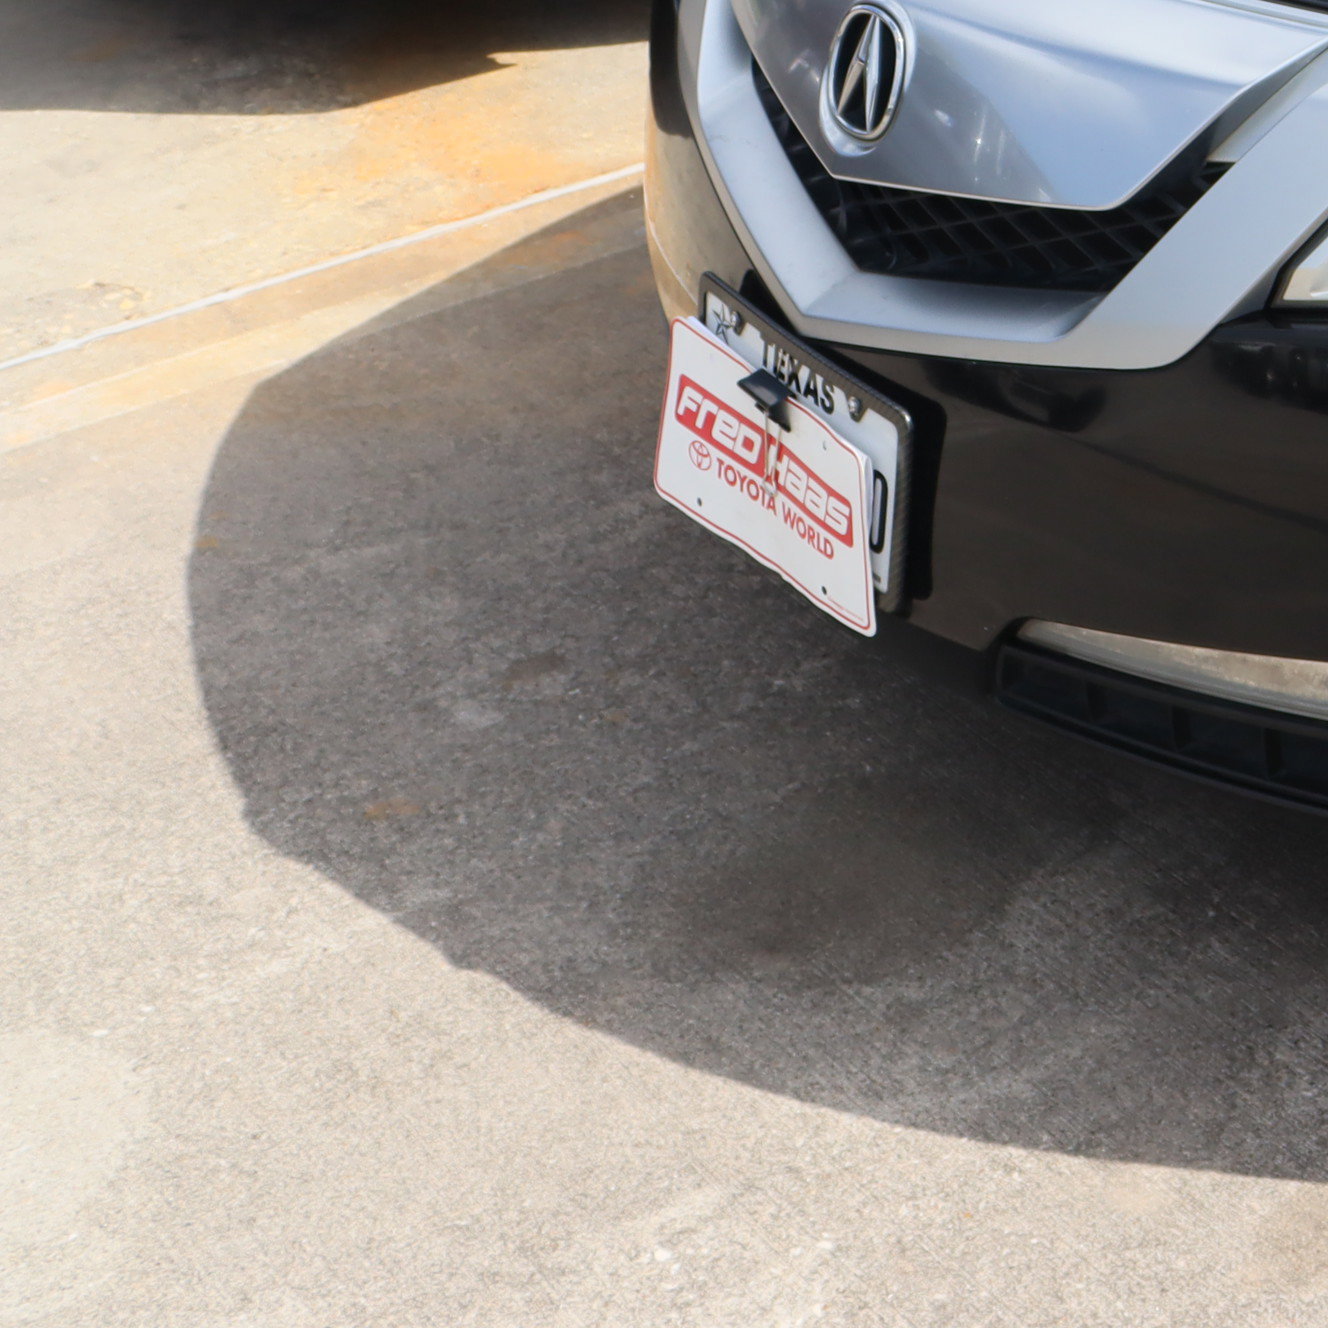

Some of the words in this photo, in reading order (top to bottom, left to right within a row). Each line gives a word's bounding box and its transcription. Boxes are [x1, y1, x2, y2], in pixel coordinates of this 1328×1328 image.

[761, 336, 836, 416] TEXAS
[715, 456, 778, 517] TOYOTA
[781, 500, 835, 561] WORLD
